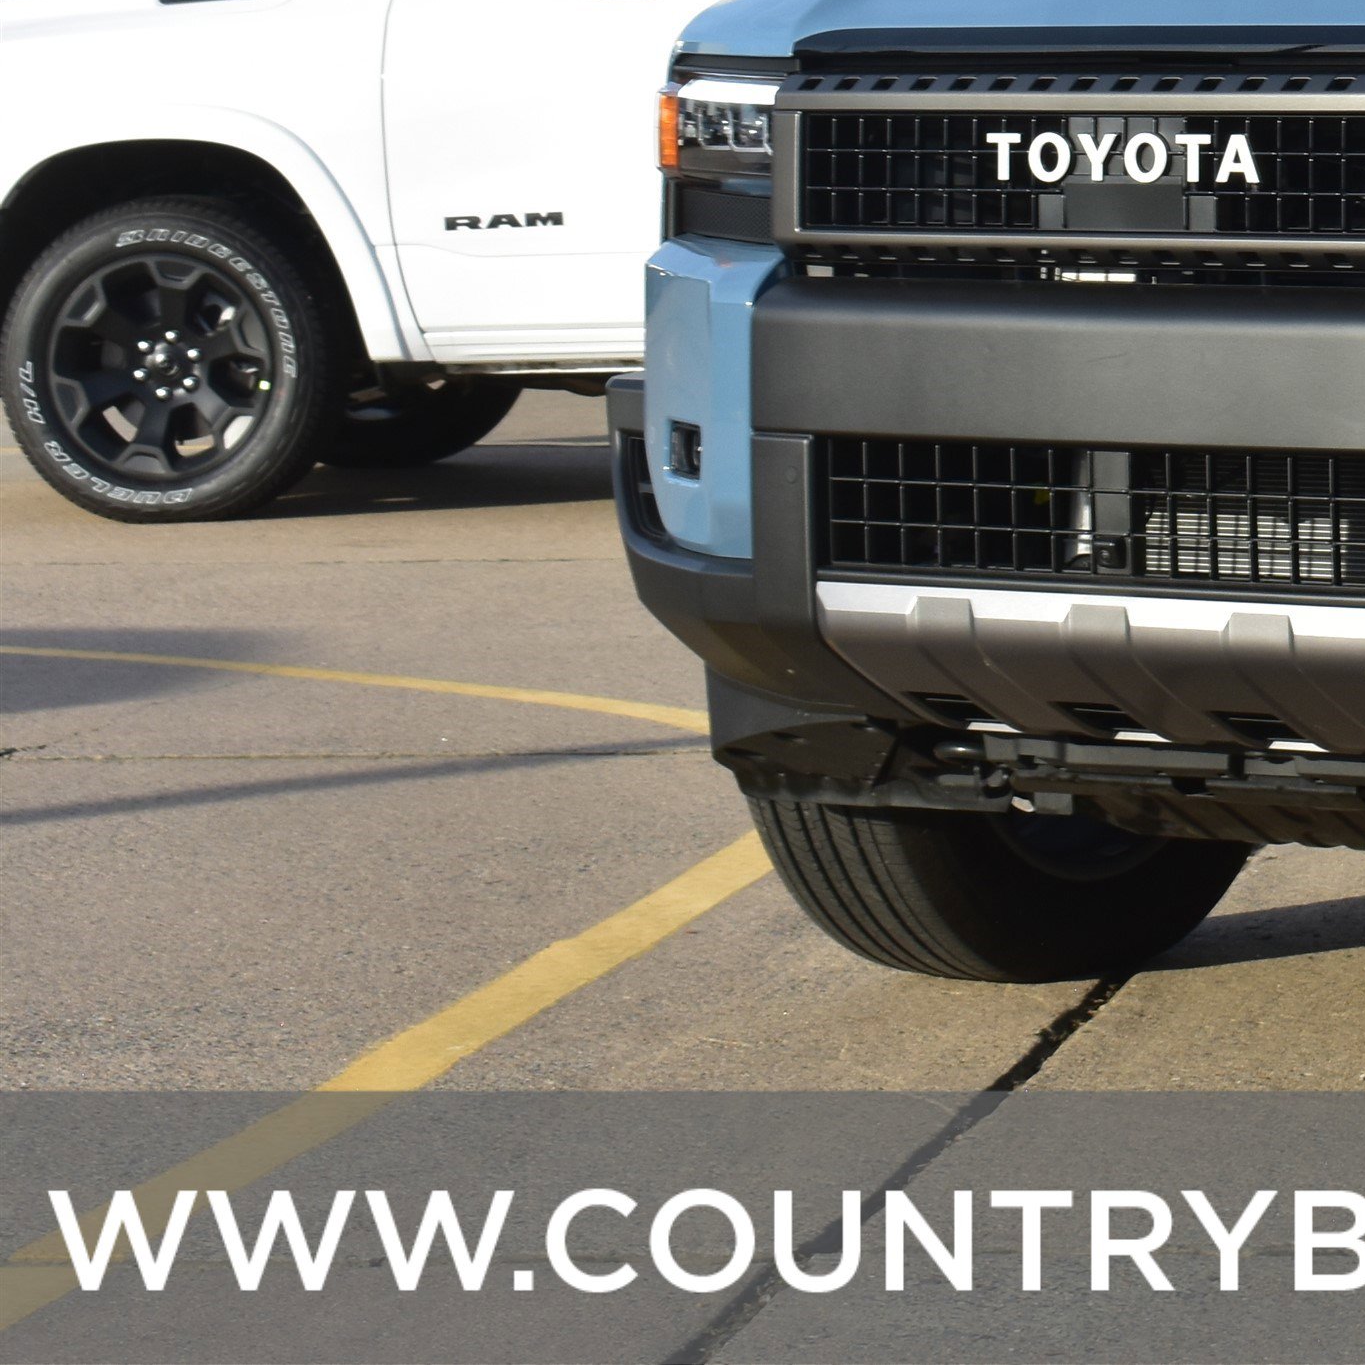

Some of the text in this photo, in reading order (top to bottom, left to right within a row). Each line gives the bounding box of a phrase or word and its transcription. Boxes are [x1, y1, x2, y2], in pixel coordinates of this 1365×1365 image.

[986, 131, 1260, 183] TOYOTA
[444, 212, 563, 231] RAM
[115, 228, 297, 378] BRIDGESTONE
[19, 360, 193, 505] DUELER H/L
